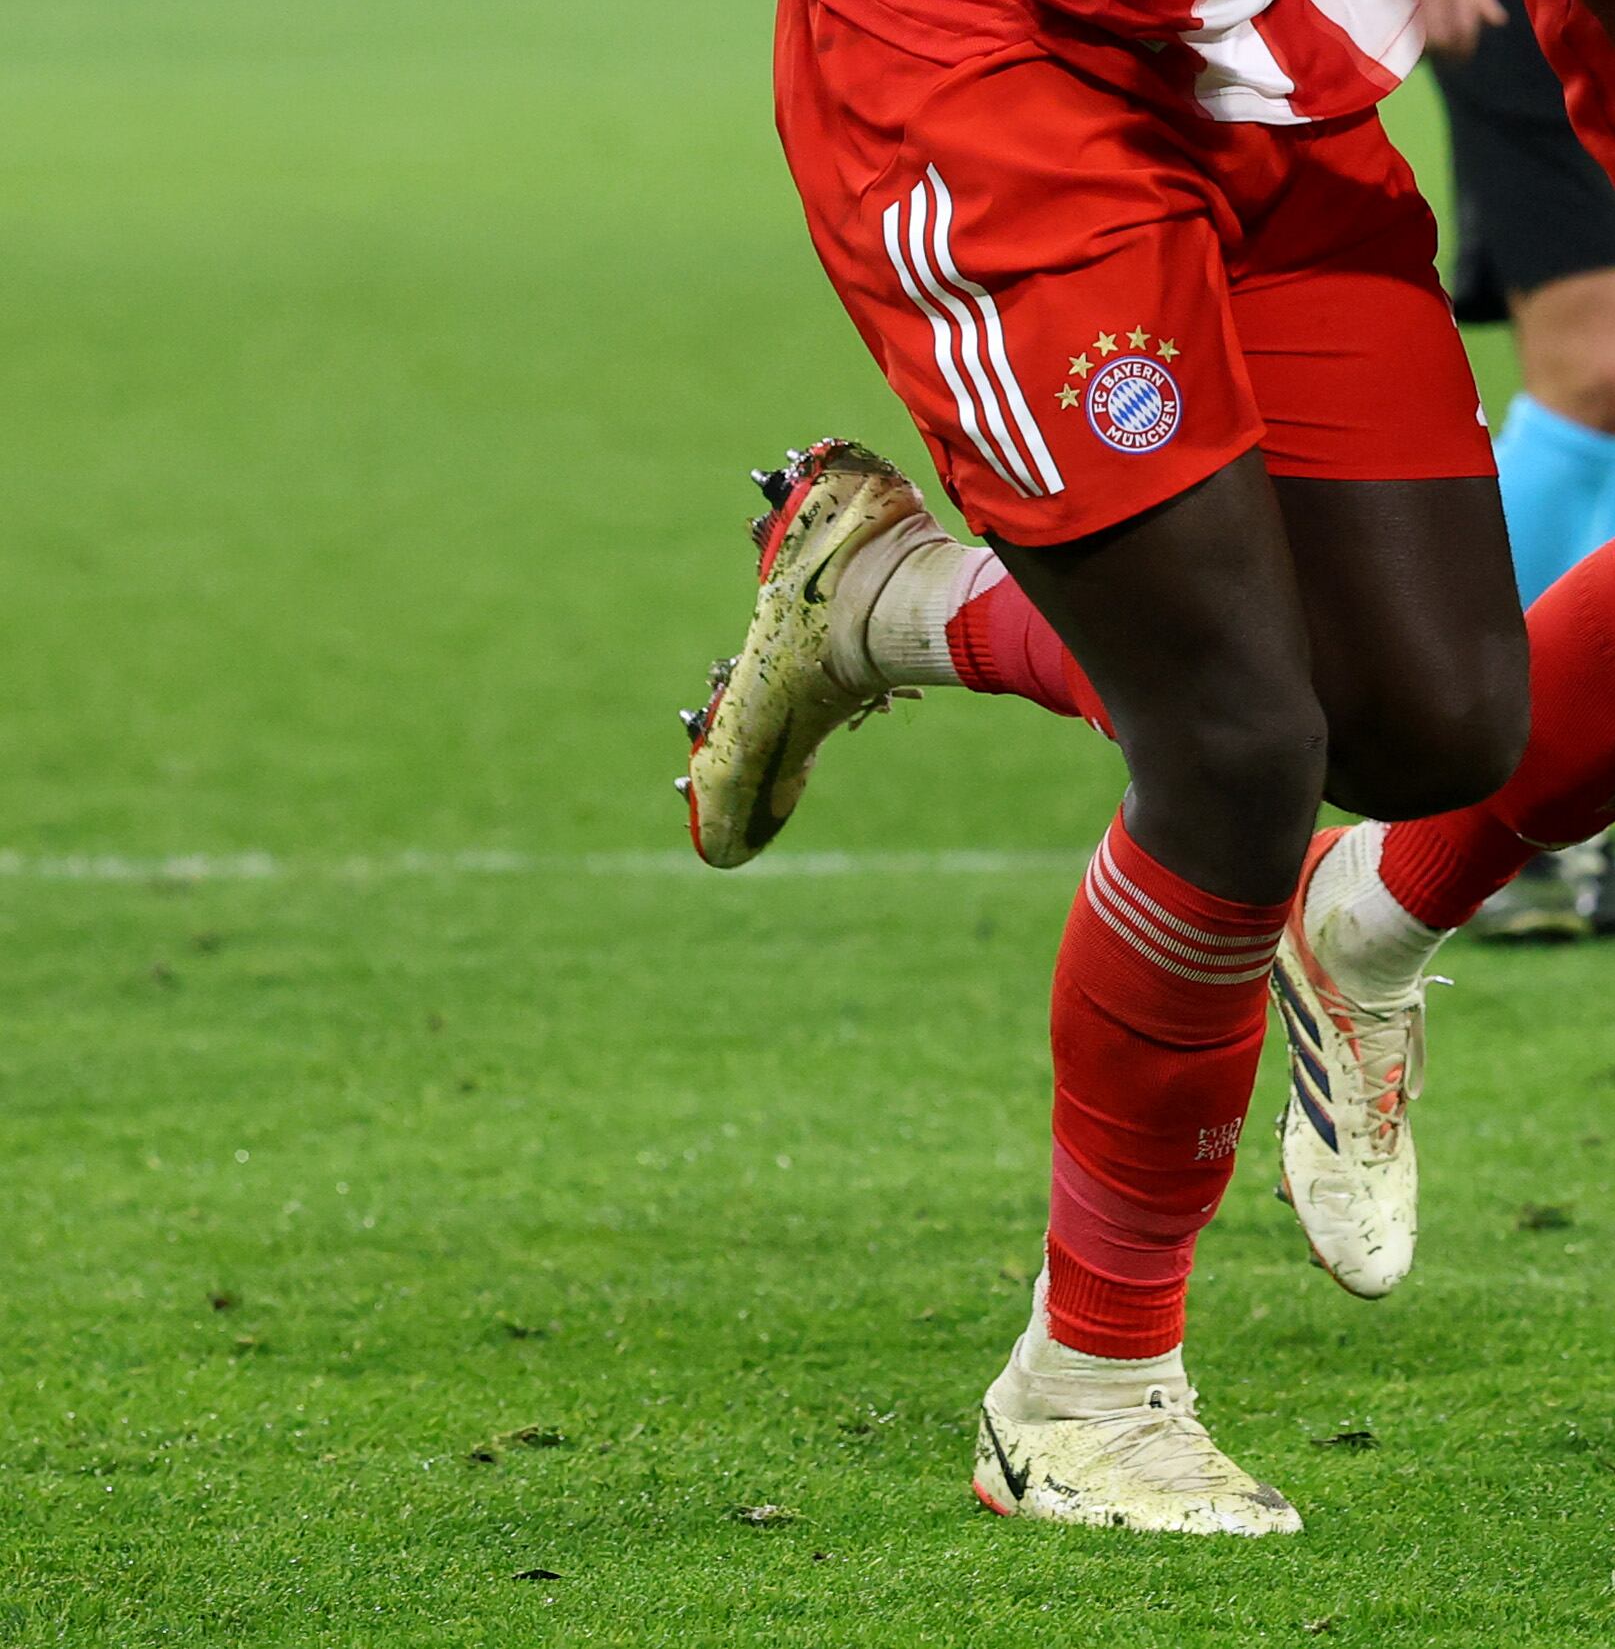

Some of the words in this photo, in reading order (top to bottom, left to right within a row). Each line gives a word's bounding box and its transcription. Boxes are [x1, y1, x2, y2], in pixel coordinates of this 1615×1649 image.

[1094, 390, 1108, 413] FC
[1101, 363, 1165, 389] BAYERN
[1106, 400, 1176, 446] MÜNCHEN
